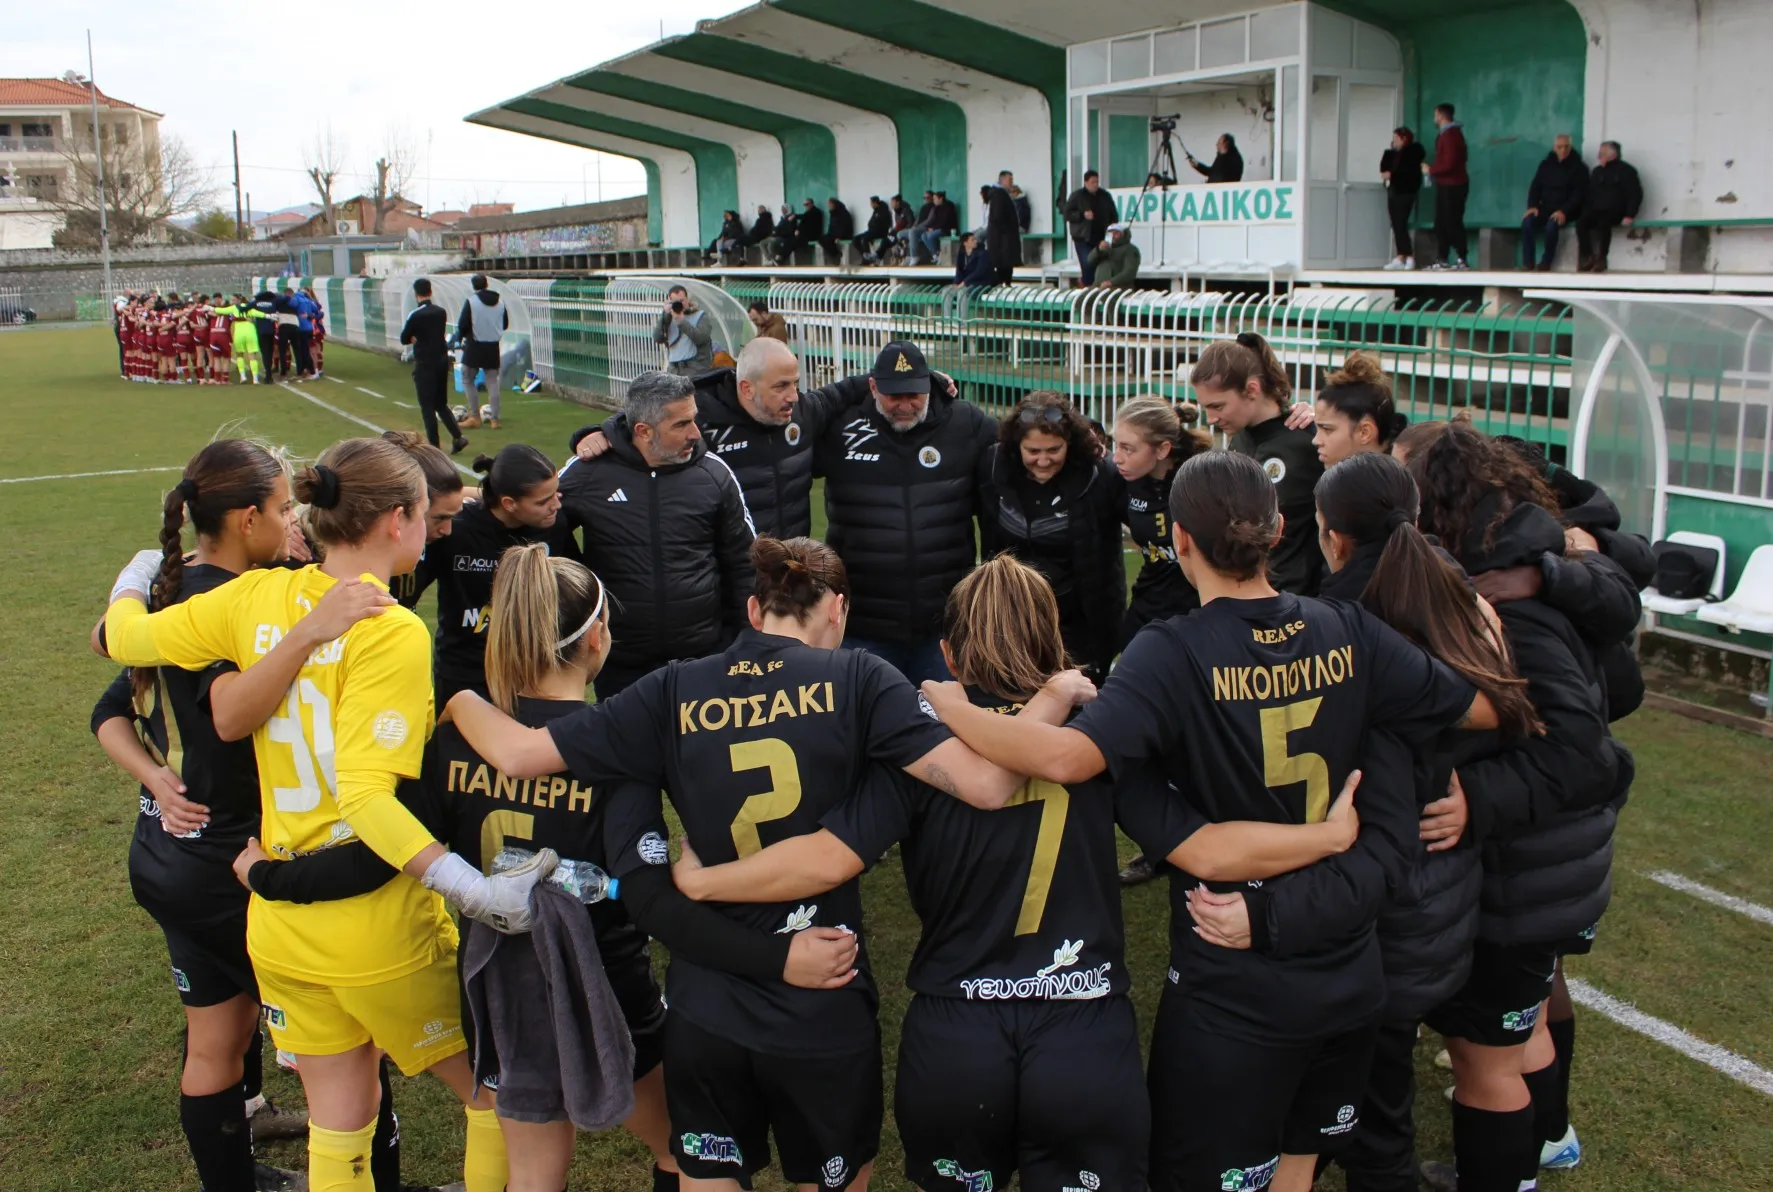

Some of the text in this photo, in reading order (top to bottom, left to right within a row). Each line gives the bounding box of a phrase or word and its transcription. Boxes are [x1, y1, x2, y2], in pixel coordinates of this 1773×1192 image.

[717, 440, 748, 454] Zeus
[845, 450, 880, 462] Zeus
[1155, 512, 1167, 537] 3
[1252, 628, 1288, 644] REA
[1213, 645, 1354, 700] ΝΙΚΟΠΟΥΛΟΥ
[679, 681, 835, 735] ΚΟΤΣΑΚΙ
[1259, 696, 1330, 825] 5
[447, 760, 593, 813] ΠΑΝΤΕΡΗ
[729, 737, 802, 860] 2
[262, 1004, 286, 1027] ΤΕΛ
